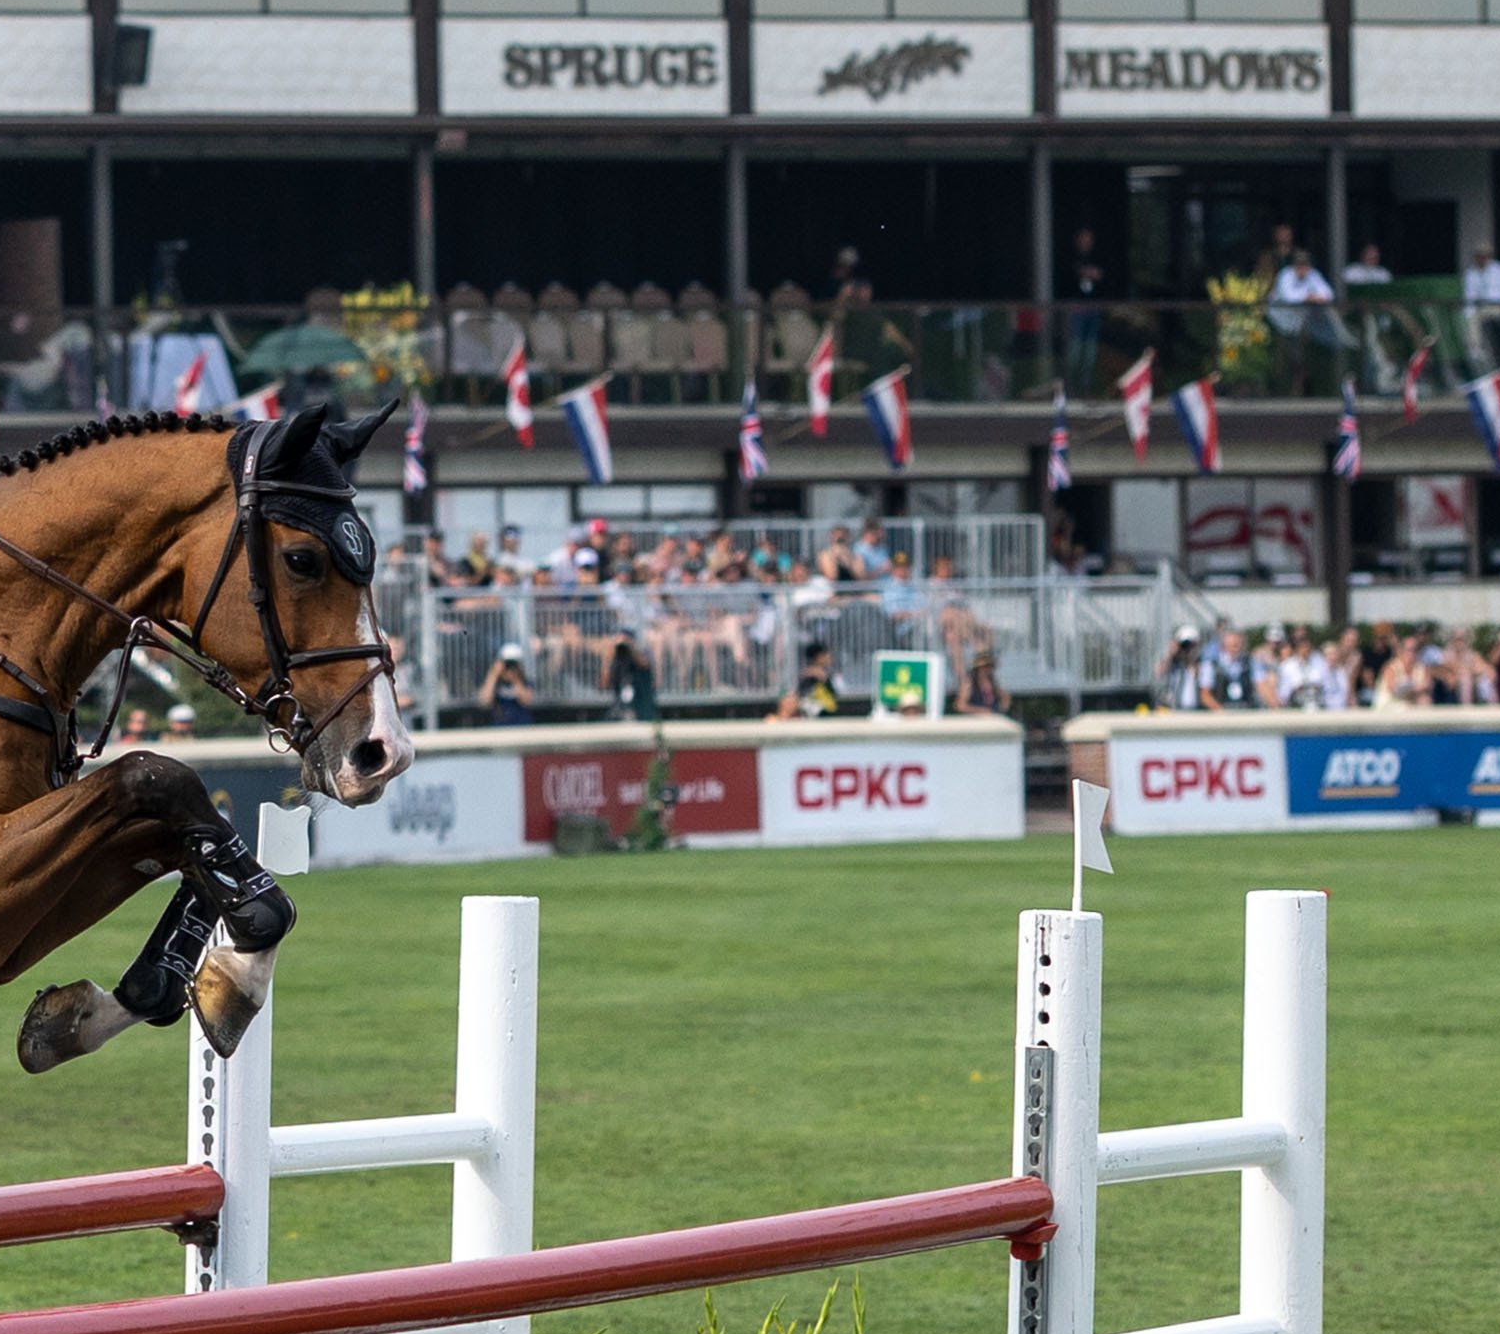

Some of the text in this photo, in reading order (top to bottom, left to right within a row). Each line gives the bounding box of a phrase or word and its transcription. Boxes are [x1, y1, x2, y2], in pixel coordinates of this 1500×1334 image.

[1064, 48, 1322, 93] MEADOWS
[795, 764, 927, 809] CPKC
[1139, 756, 1264, 800] CPKC
[1322, 749, 1400, 785] ATCO
